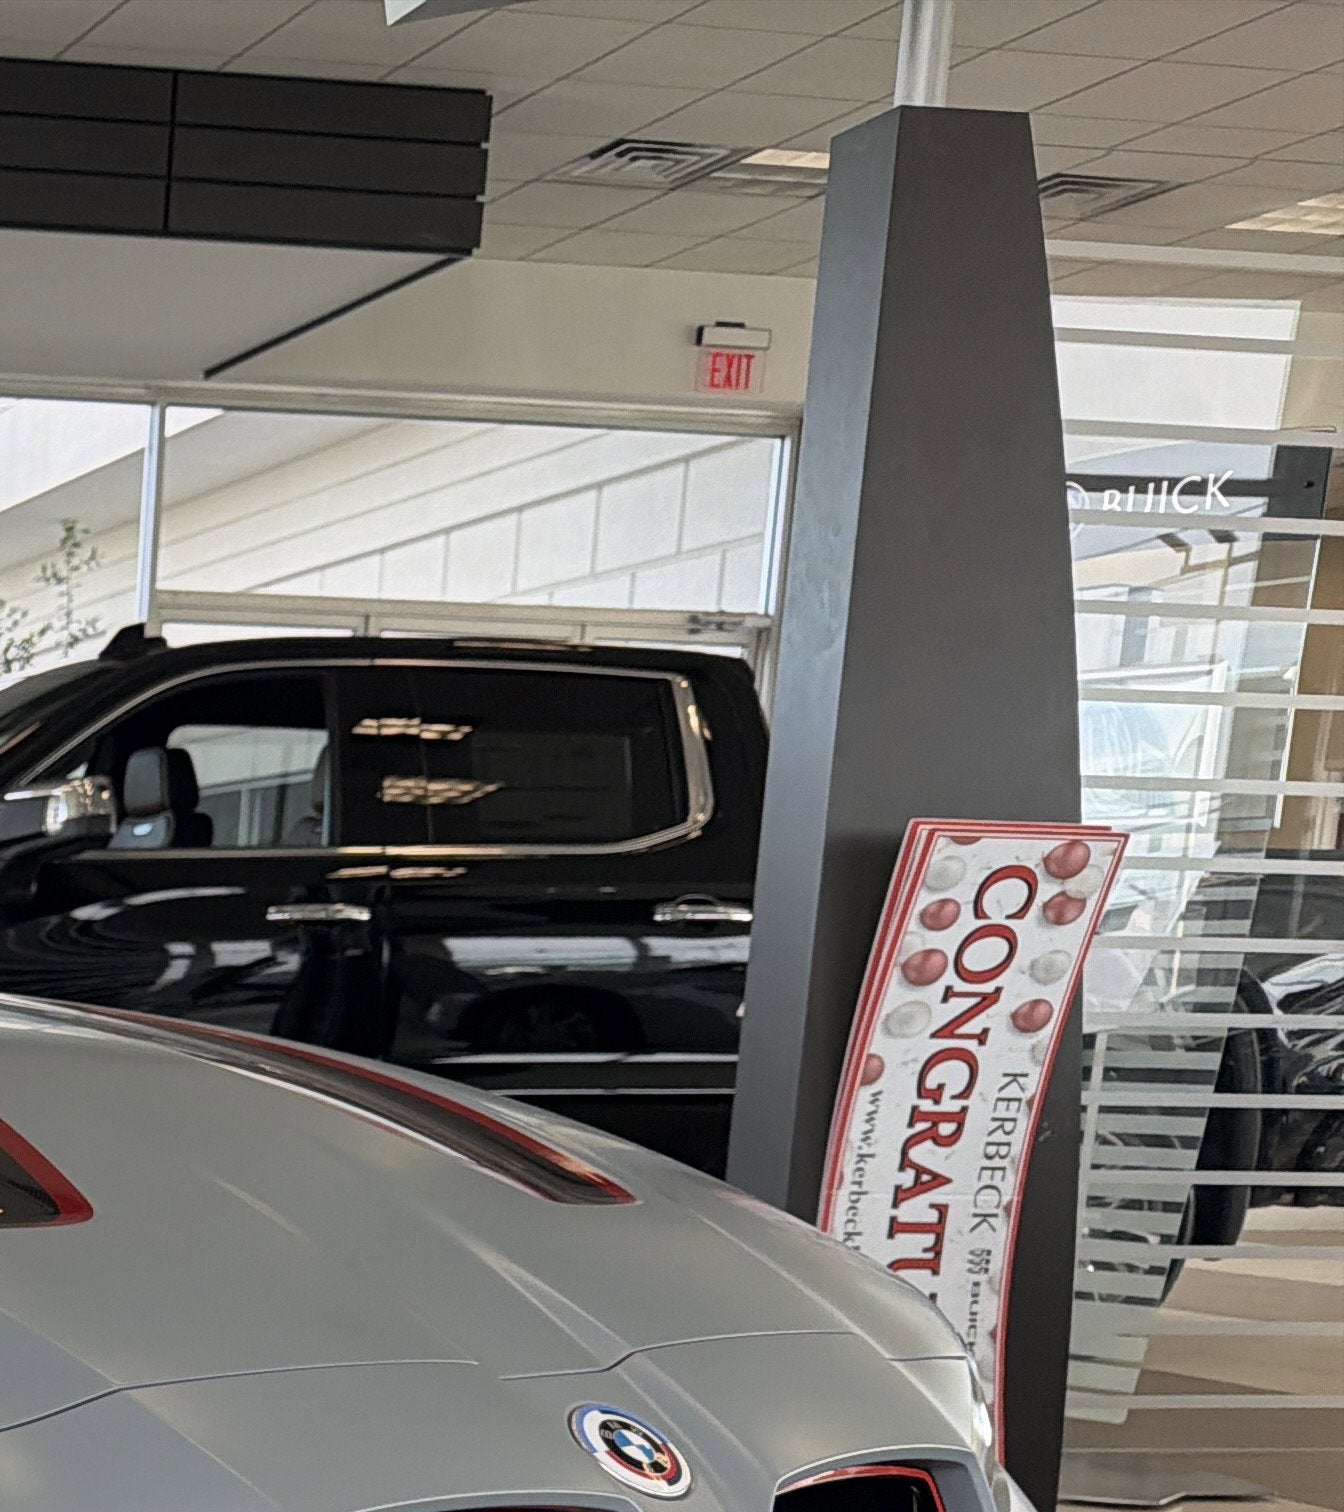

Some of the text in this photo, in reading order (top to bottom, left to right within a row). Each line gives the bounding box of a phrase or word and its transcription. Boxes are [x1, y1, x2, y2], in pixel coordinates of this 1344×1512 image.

[709, 351, 755, 390] EXIT
[842, 1089, 883, 1252] www.kerbeck
[968, 1072, 1029, 1233] KERBECK
